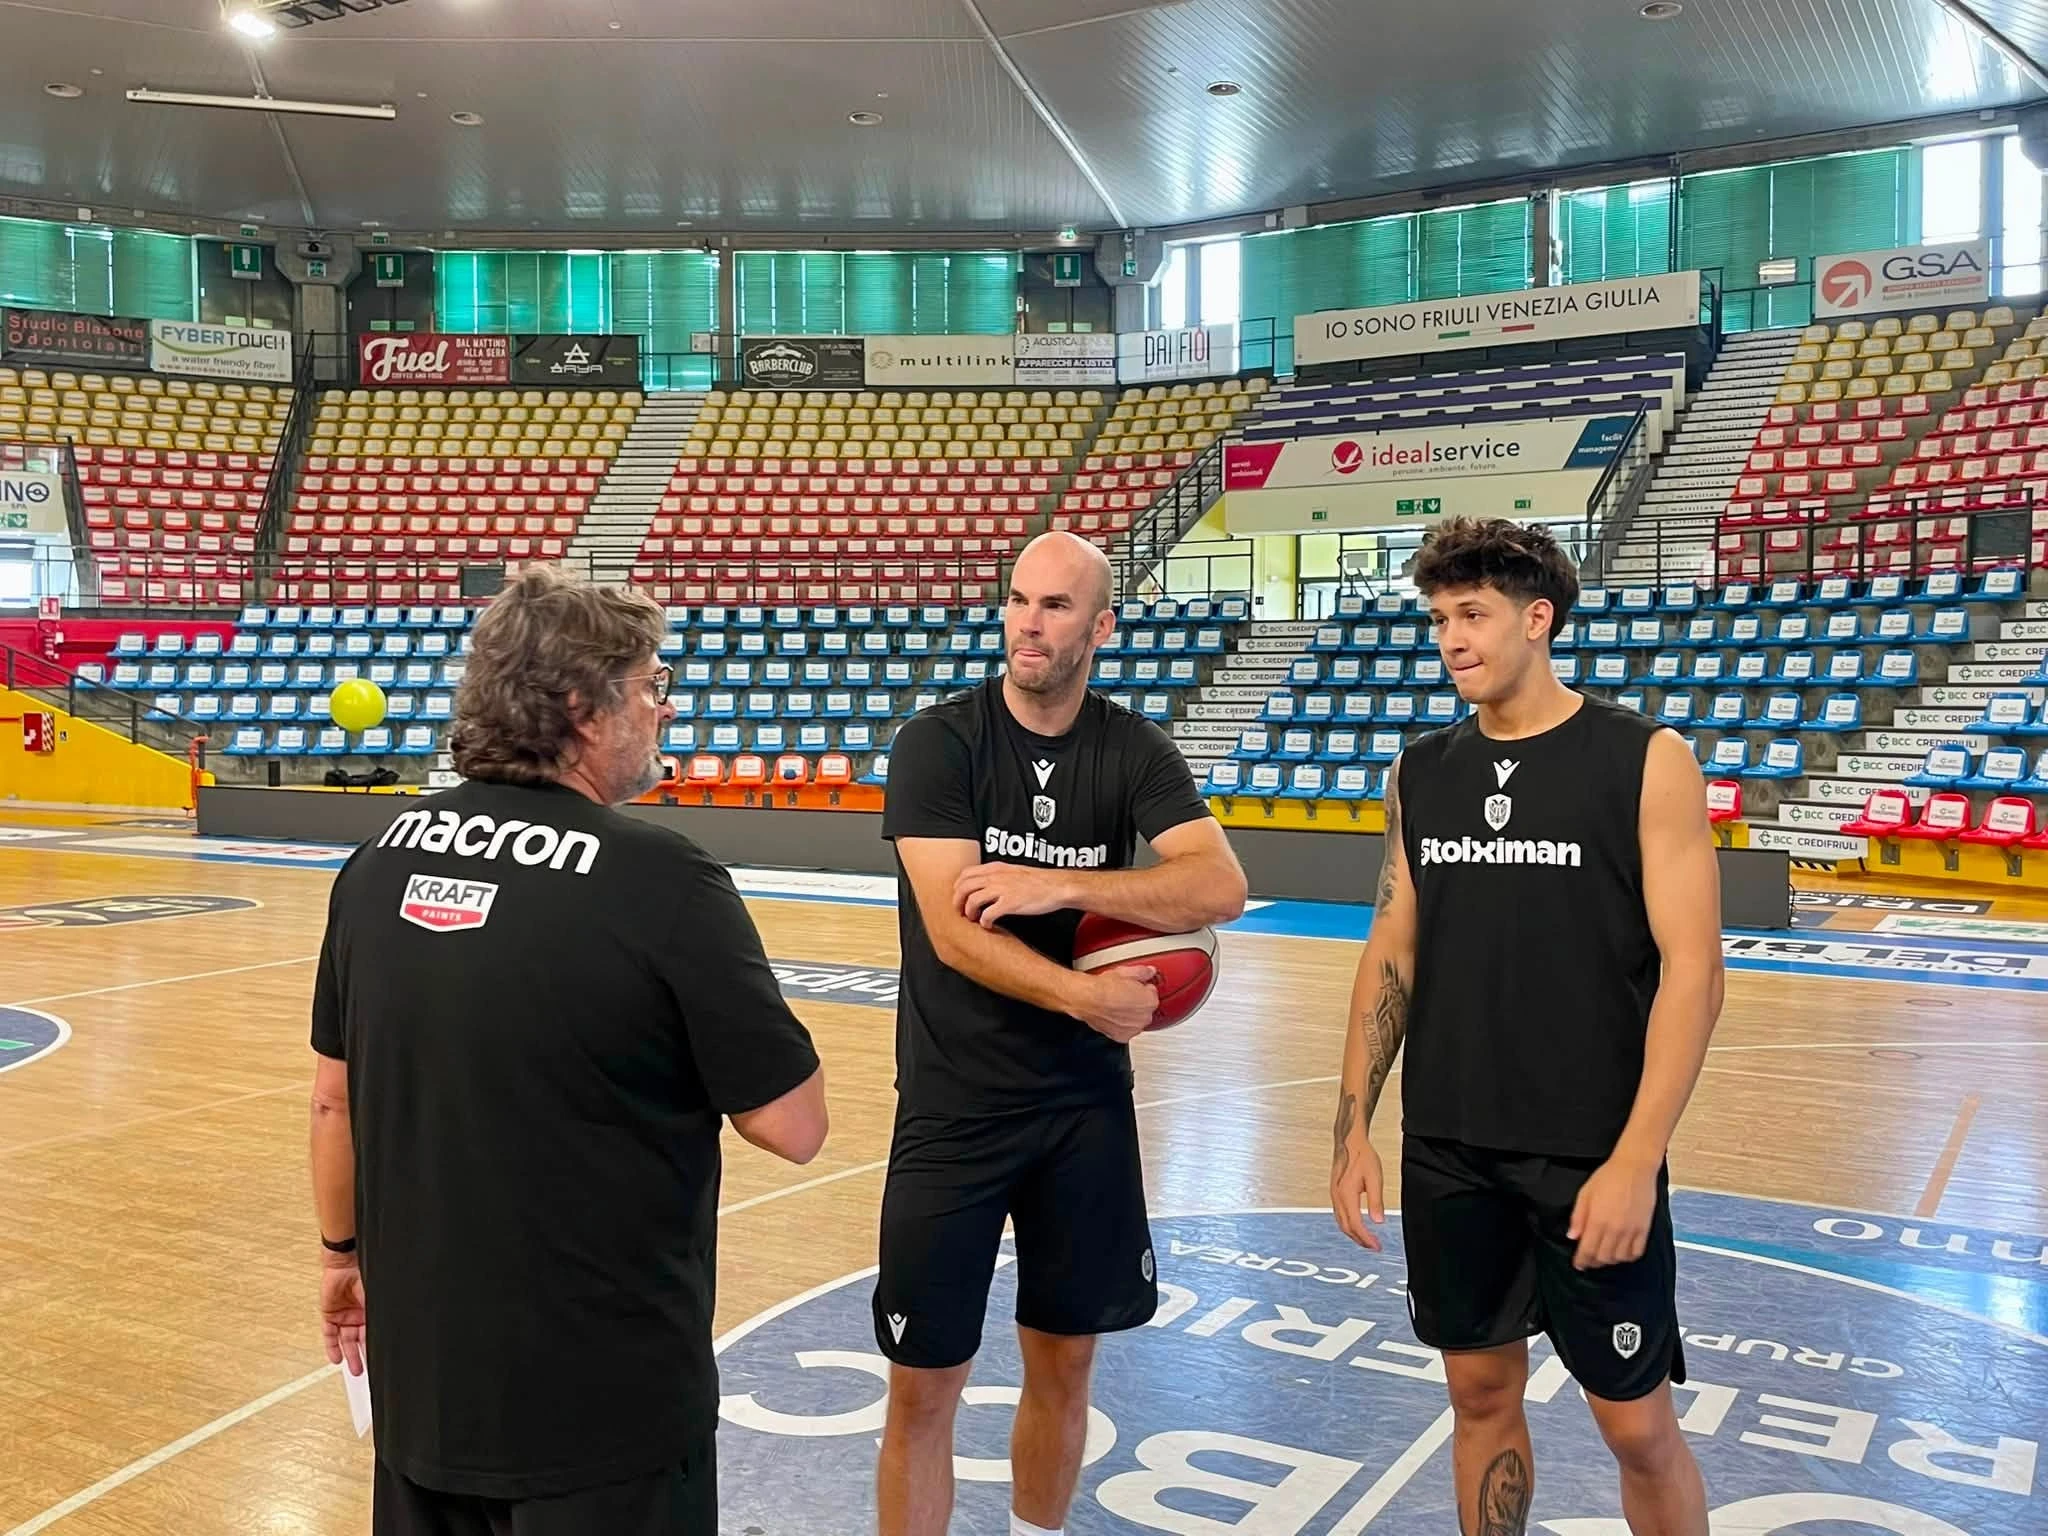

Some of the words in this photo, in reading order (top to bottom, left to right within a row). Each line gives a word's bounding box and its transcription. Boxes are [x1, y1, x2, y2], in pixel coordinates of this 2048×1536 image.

[1326, 321, 1347, 339] IO
[1354, 313, 1416, 336] SONO
[1423, 306, 1480, 328] FRIULI
[1487, 296, 1578, 321] VENEZIA
[1586, 286, 1660, 310] GIULIA
[1145, 334, 1171, 366] DAI
[364, 337, 450, 382] Fuel
[900, 354, 1011, 367] multilink
[1372, 438, 1521, 466] idealservice
[2027, 626, 2047, 634] BCC
[2001, 648, 2020, 656] BCC
[1974, 669, 1994, 677] BCC
[1948, 692, 1968, 700] BCC
[1920, 715, 1940, 723] BCC
[1892, 737, 1911, 746] BCC
[1863, 761, 1883, 770] BCC
[1835, 786, 1853, 795] BCC
[1804, 811, 1824, 820] BCC
[377, 809, 600, 874] macron
[1773, 835, 1792, 845] BCC
[1797, 838, 1858, 850] CREDIFRIULI
[1421, 836, 1582, 867] Stoiximan
[408, 878, 493, 907] KRAFT
[421, 908, 462, 922] PAINTS
[1846, 944, 2032, 970] DEL
[1170, 1240, 1380, 1289] ICCREA
[1678, 1326, 1904, 1379] GRUP
